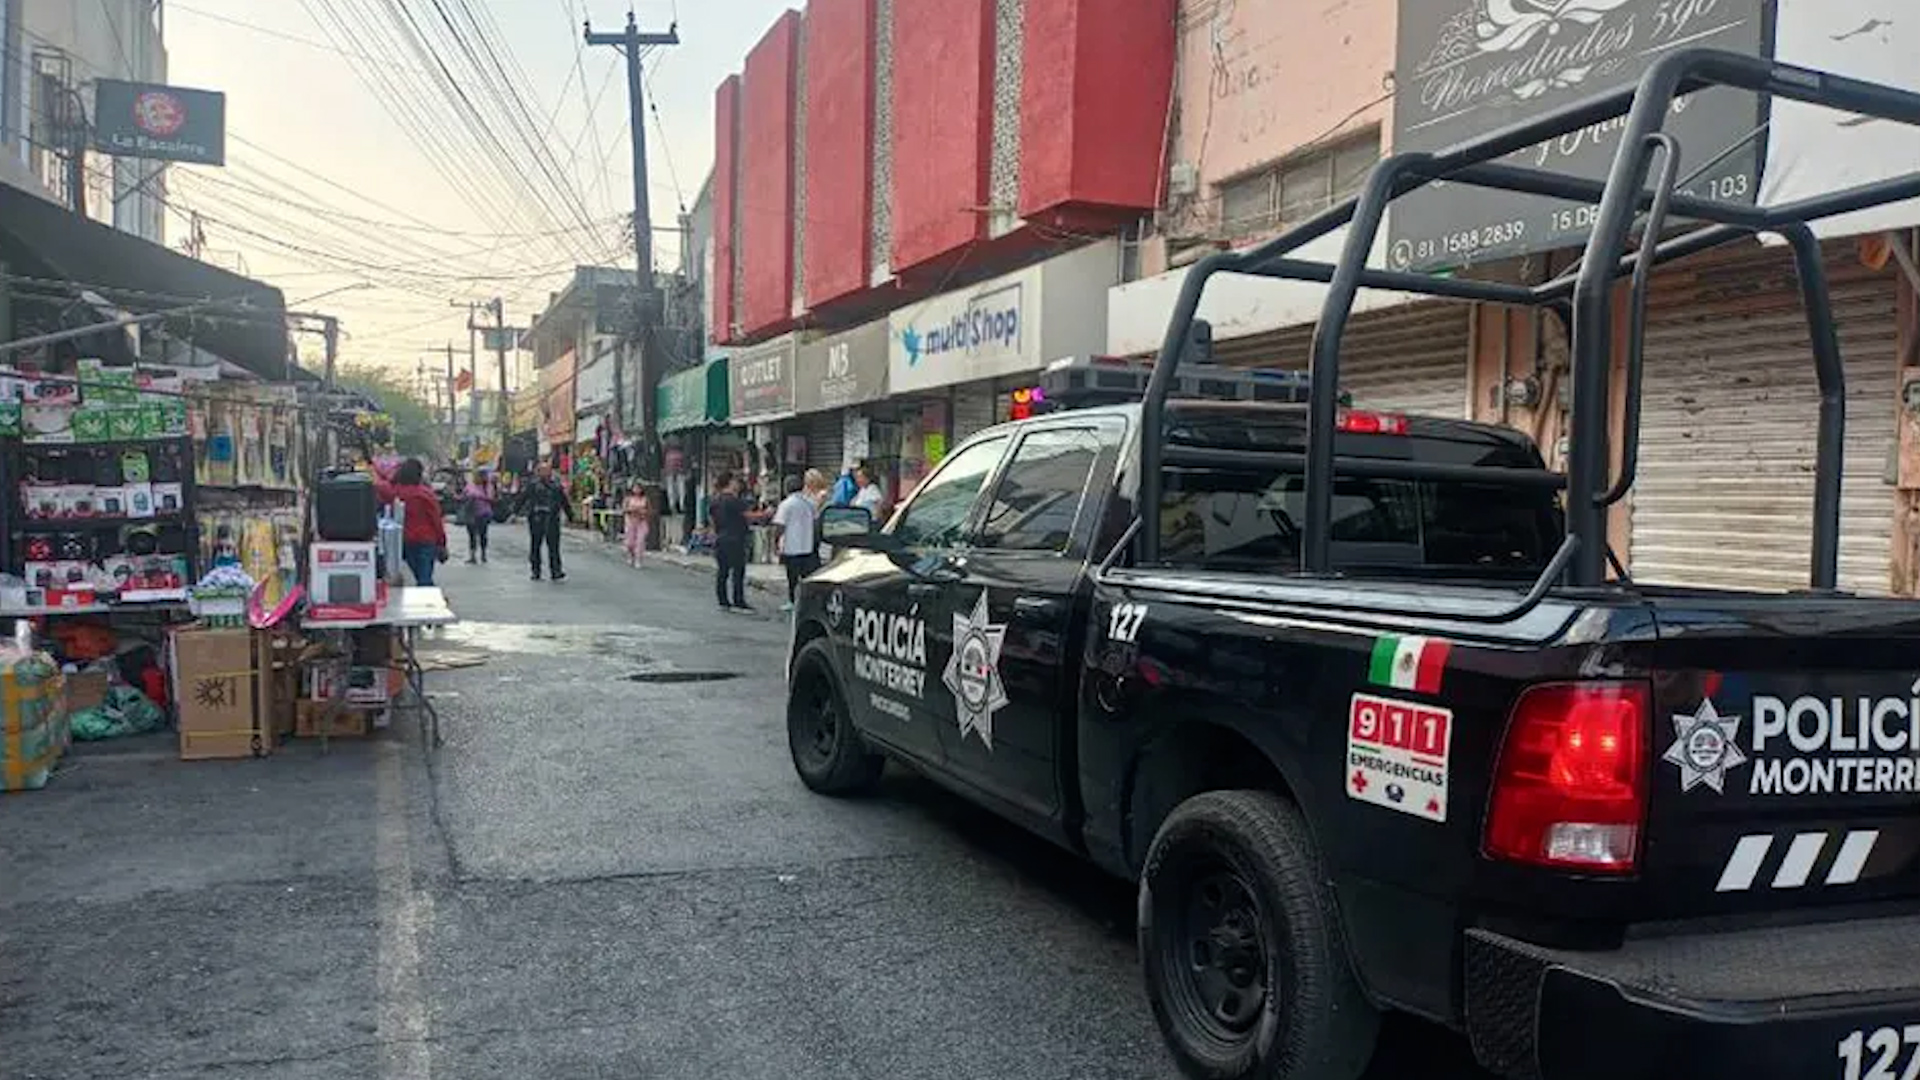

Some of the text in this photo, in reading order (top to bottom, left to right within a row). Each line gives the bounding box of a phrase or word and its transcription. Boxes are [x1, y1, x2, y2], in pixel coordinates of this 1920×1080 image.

[1710, 174, 1748, 201] 103
[741, 355, 782, 386] OUTLET
[853, 602, 926, 667] POLICÍA
[1108, 603, 1148, 642] 127
[854, 651, 925, 699] MONTERREY
[1351, 752, 1443, 787] EMERGENCIAS
